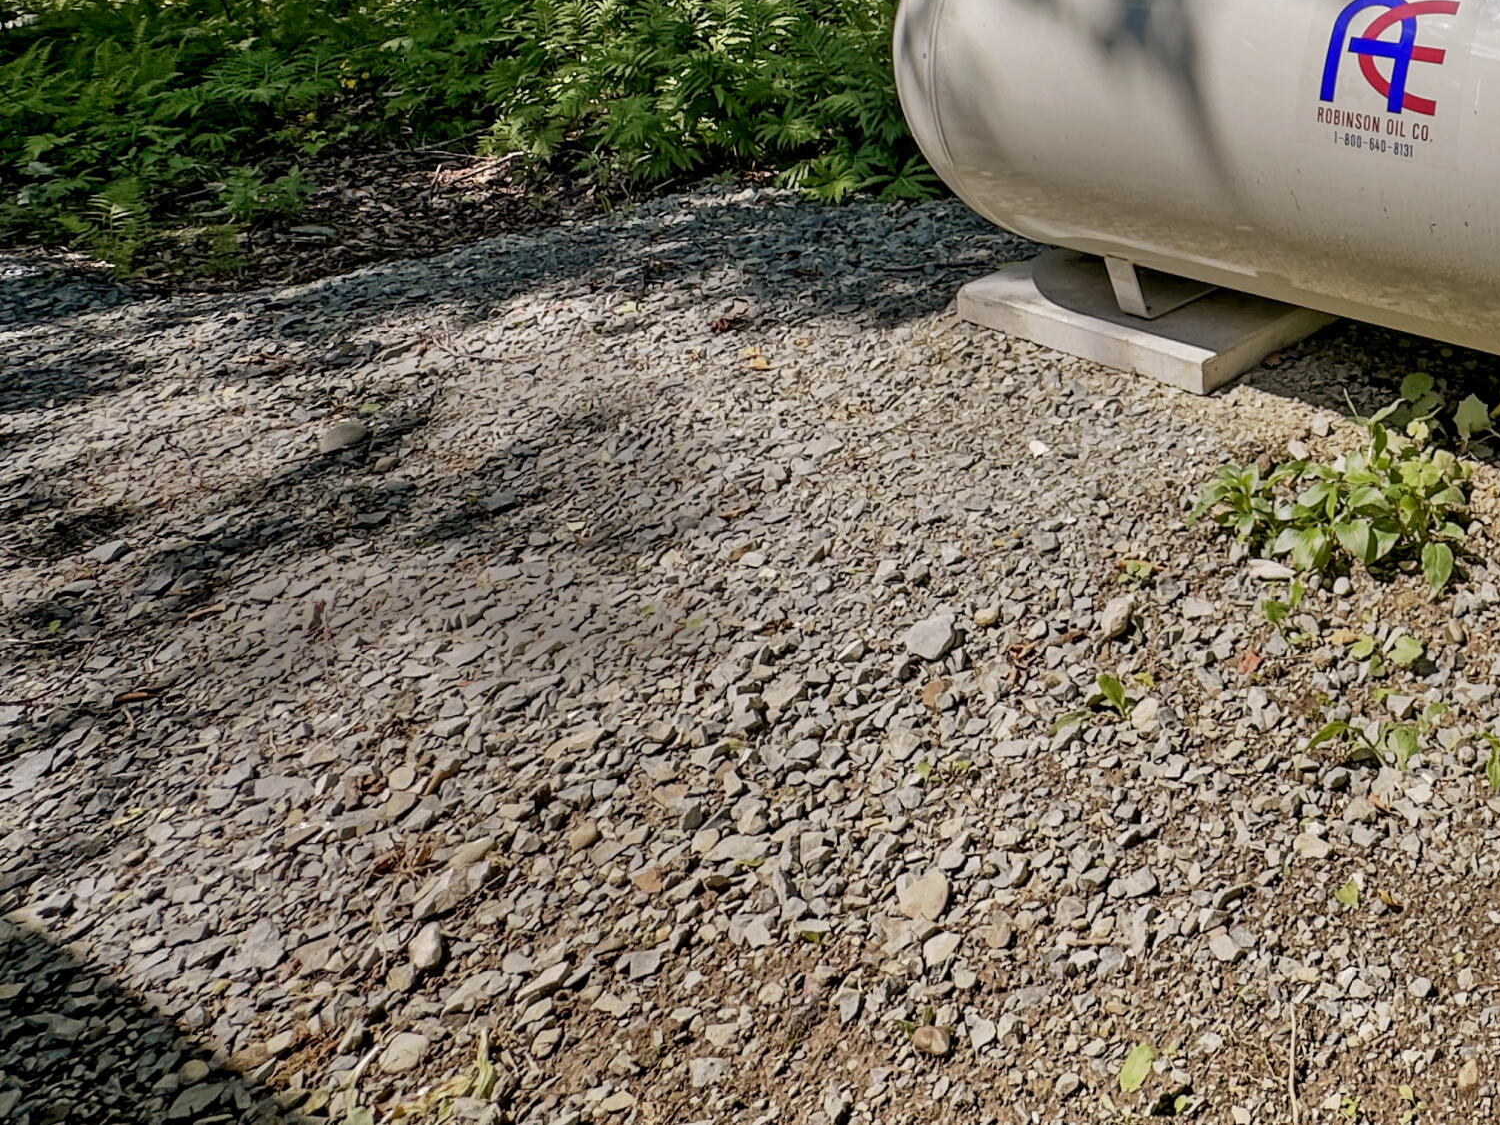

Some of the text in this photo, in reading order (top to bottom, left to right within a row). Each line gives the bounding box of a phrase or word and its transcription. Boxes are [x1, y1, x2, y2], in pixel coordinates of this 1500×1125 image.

[1317, 106, 1433, 142] ROBINSON OIL CO.
[1334, 131, 1413, 157] 1-800-640-8131
